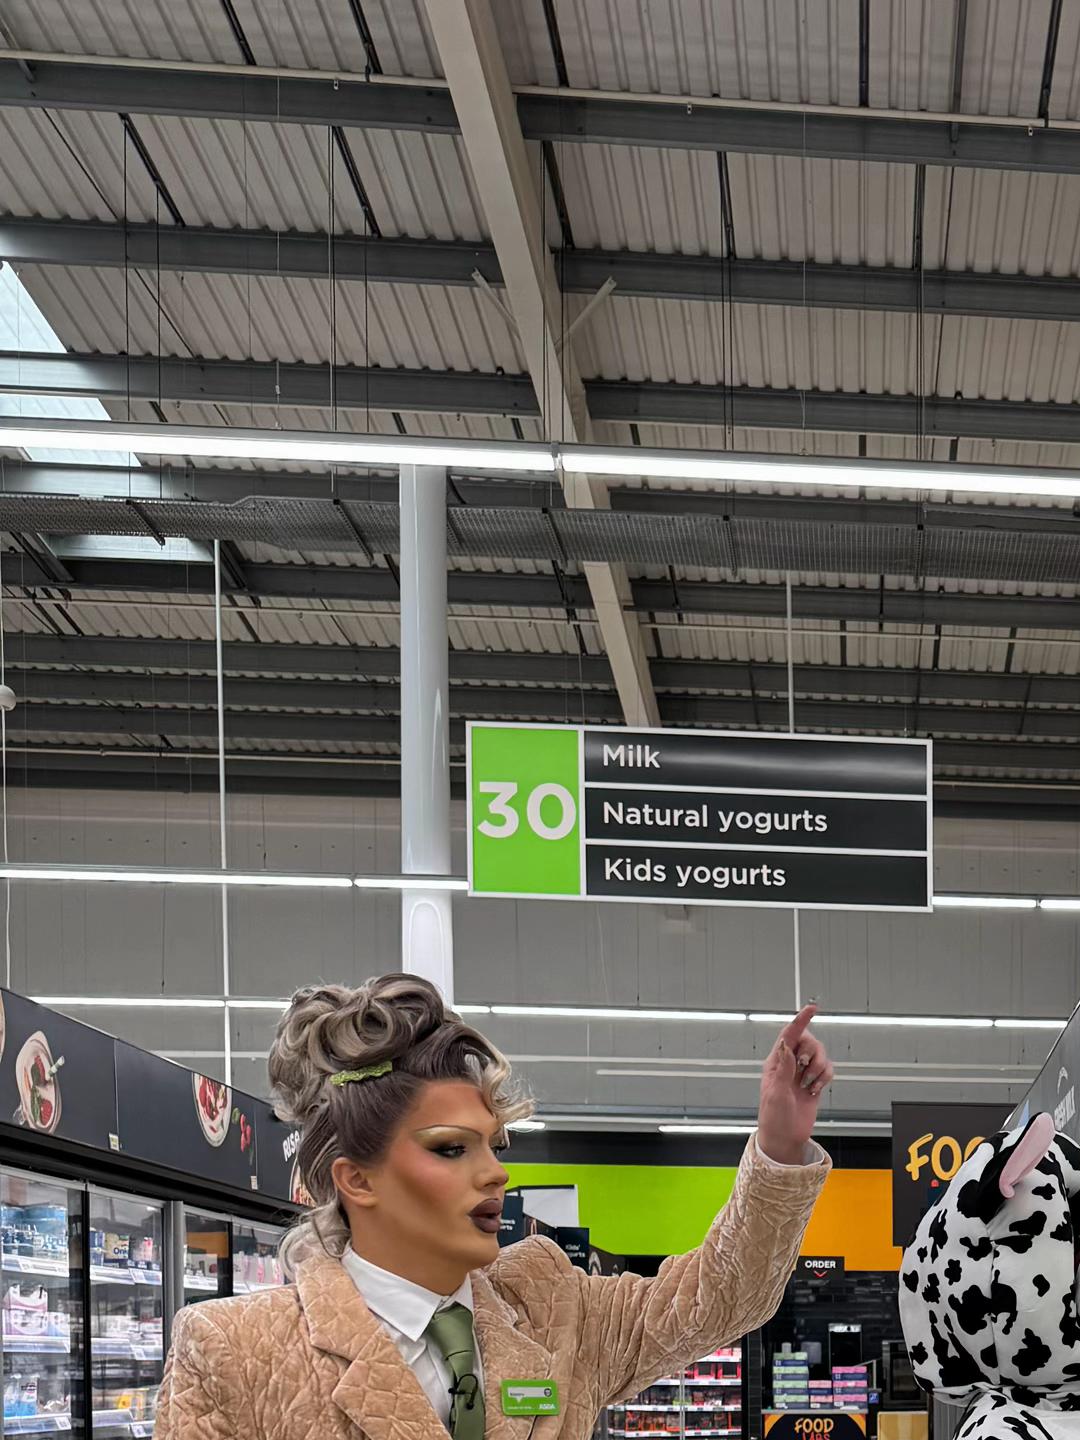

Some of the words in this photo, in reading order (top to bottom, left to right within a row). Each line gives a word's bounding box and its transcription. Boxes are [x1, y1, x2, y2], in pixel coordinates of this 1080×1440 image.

[602, 744, 660, 768] Milk
[477, 781, 576, 840] 30
[602, 801, 708, 828] Natural
[718, 806, 828, 834] yogurts
[603, 858, 666, 882] Kids
[676, 862, 786, 888] yogurts
[805, 1260, 837, 1269] ORDER
[794, 1418, 834, 1433] FOOD
